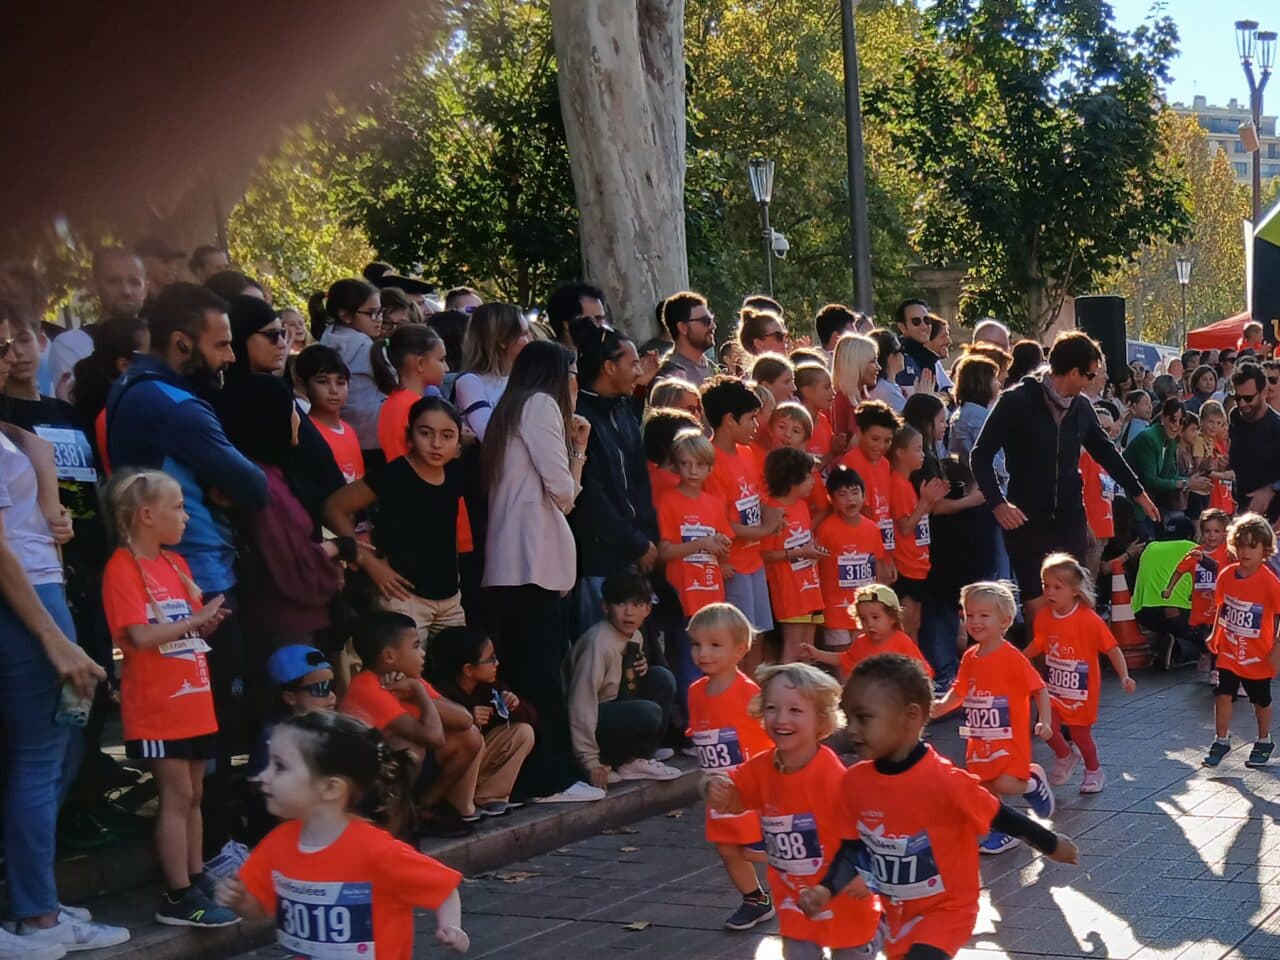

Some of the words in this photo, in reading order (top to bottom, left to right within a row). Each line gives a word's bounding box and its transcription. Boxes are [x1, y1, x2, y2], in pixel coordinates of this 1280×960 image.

[1224, 606, 1254, 628] 3083
[1047, 666, 1081, 689] 3088
[964, 707, 1001, 728] 3020
[697, 743, 732, 768] 093
[765, 831, 807, 859] 098
[871, 854, 918, 884] 077
[281, 899, 352, 943] 3019
